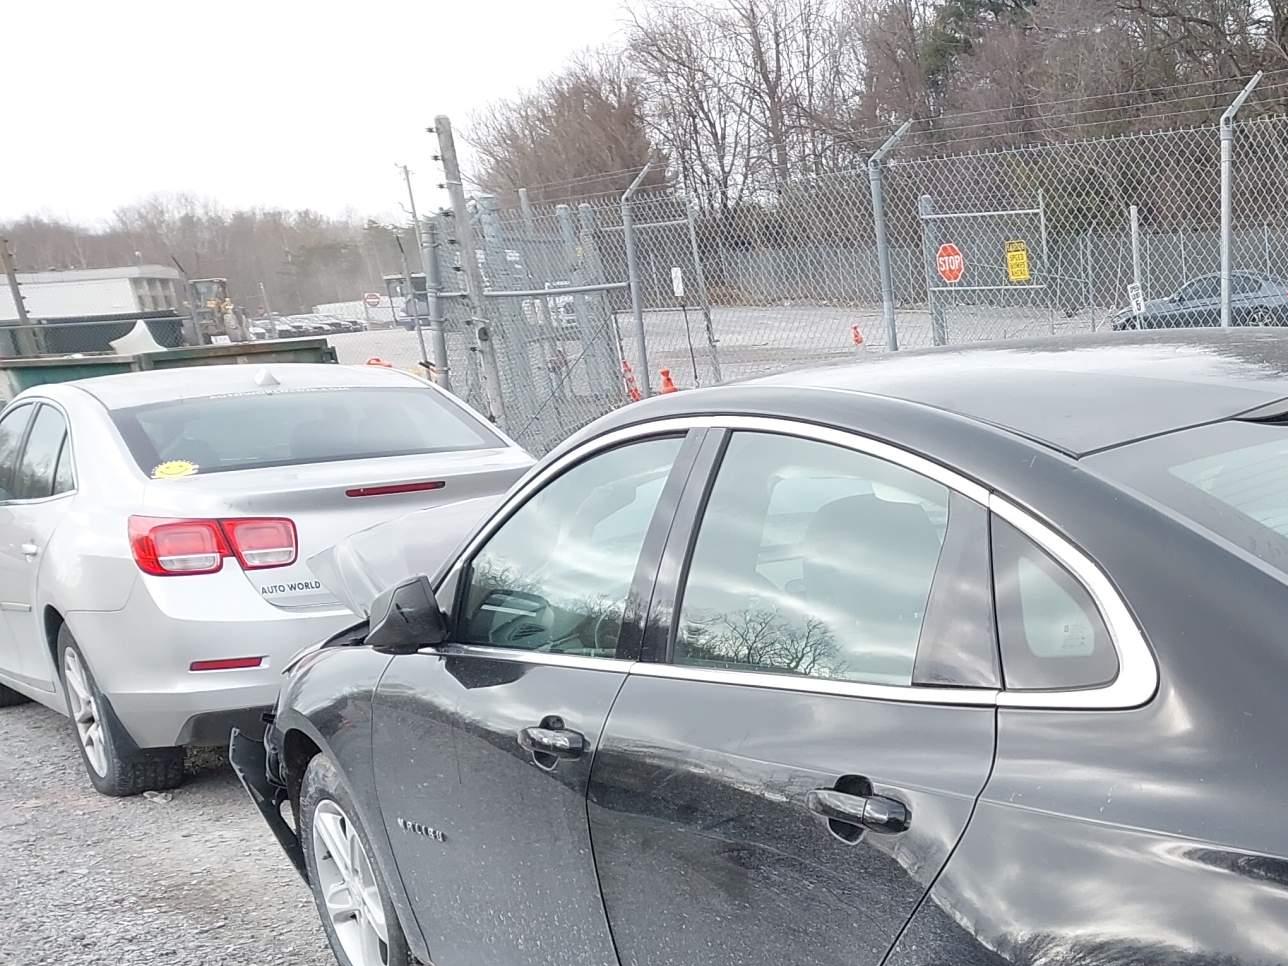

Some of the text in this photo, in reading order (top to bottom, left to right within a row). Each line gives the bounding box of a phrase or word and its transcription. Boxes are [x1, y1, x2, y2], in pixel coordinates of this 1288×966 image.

[939, 255, 960, 271] STOP
[261, 580, 321, 594] AUTO WORLD
